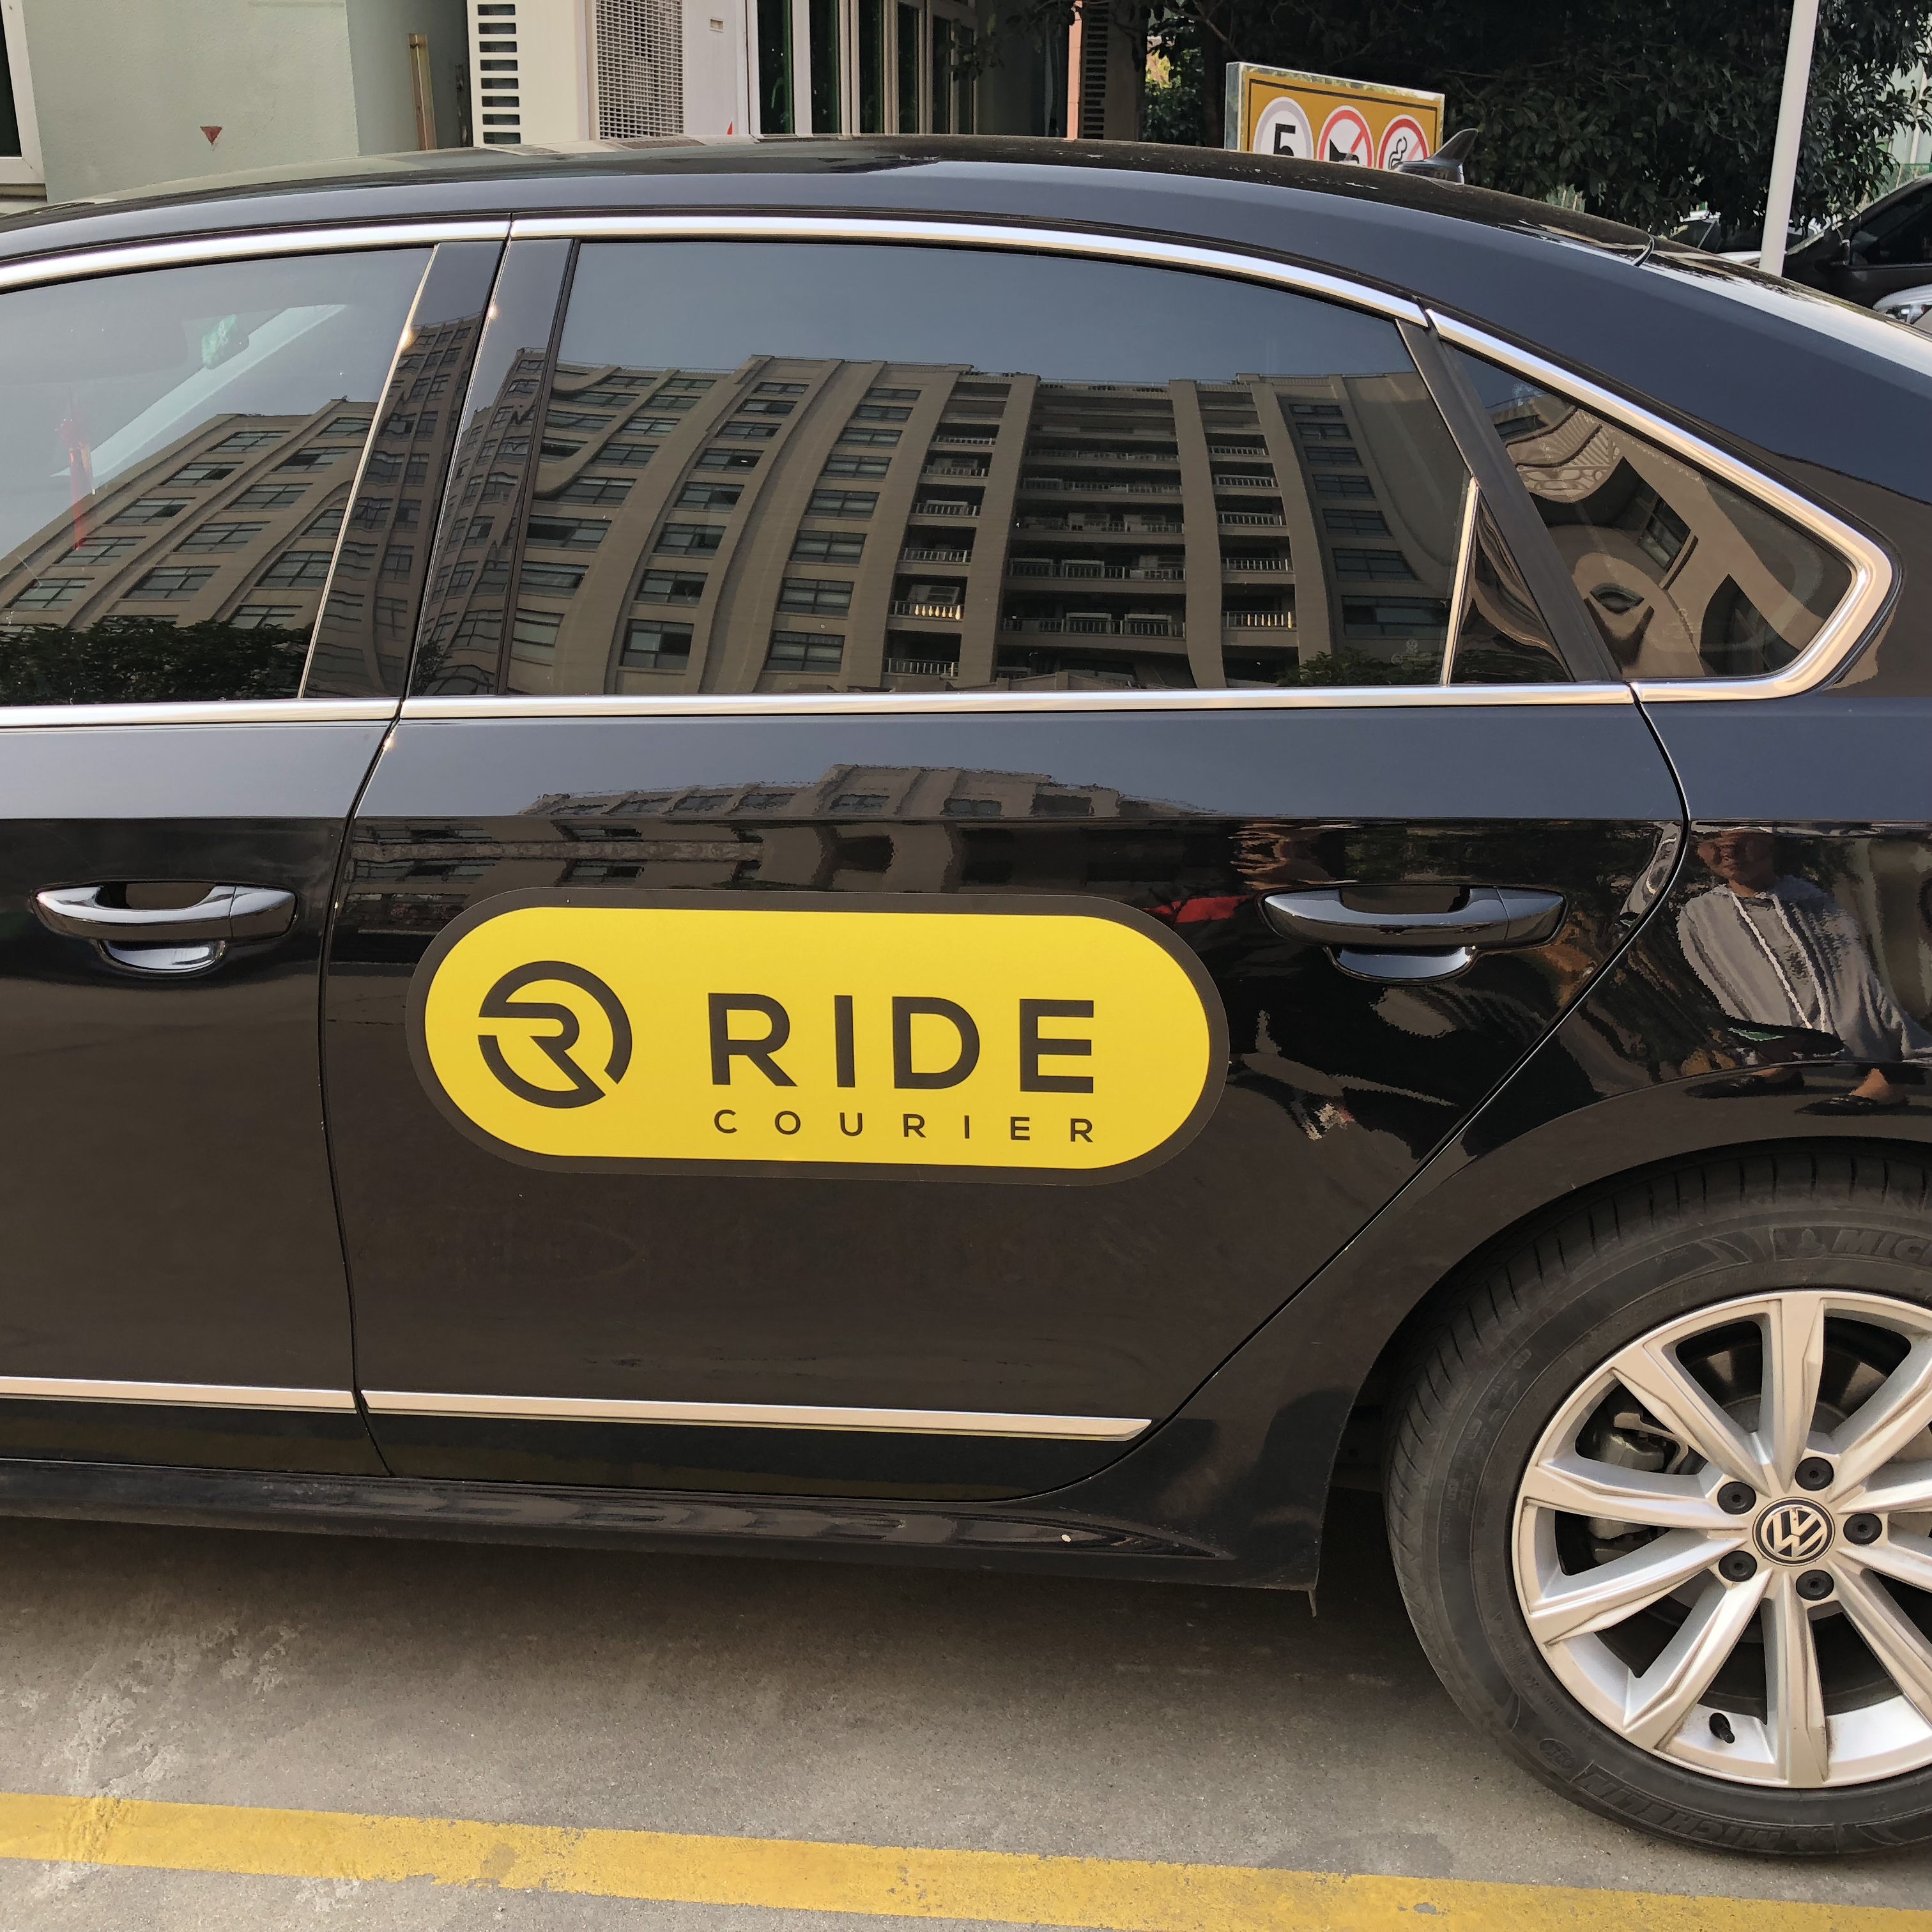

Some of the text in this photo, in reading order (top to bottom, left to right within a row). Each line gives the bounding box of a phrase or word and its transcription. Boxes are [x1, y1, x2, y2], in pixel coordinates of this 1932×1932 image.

[1274, 123, 1296, 157] 5
[708, 993, 1094, 1093] RIDE
[714, 1110, 1094, 1142] COURIER
[1575, 1774, 1782, 1849] MICHELIN
